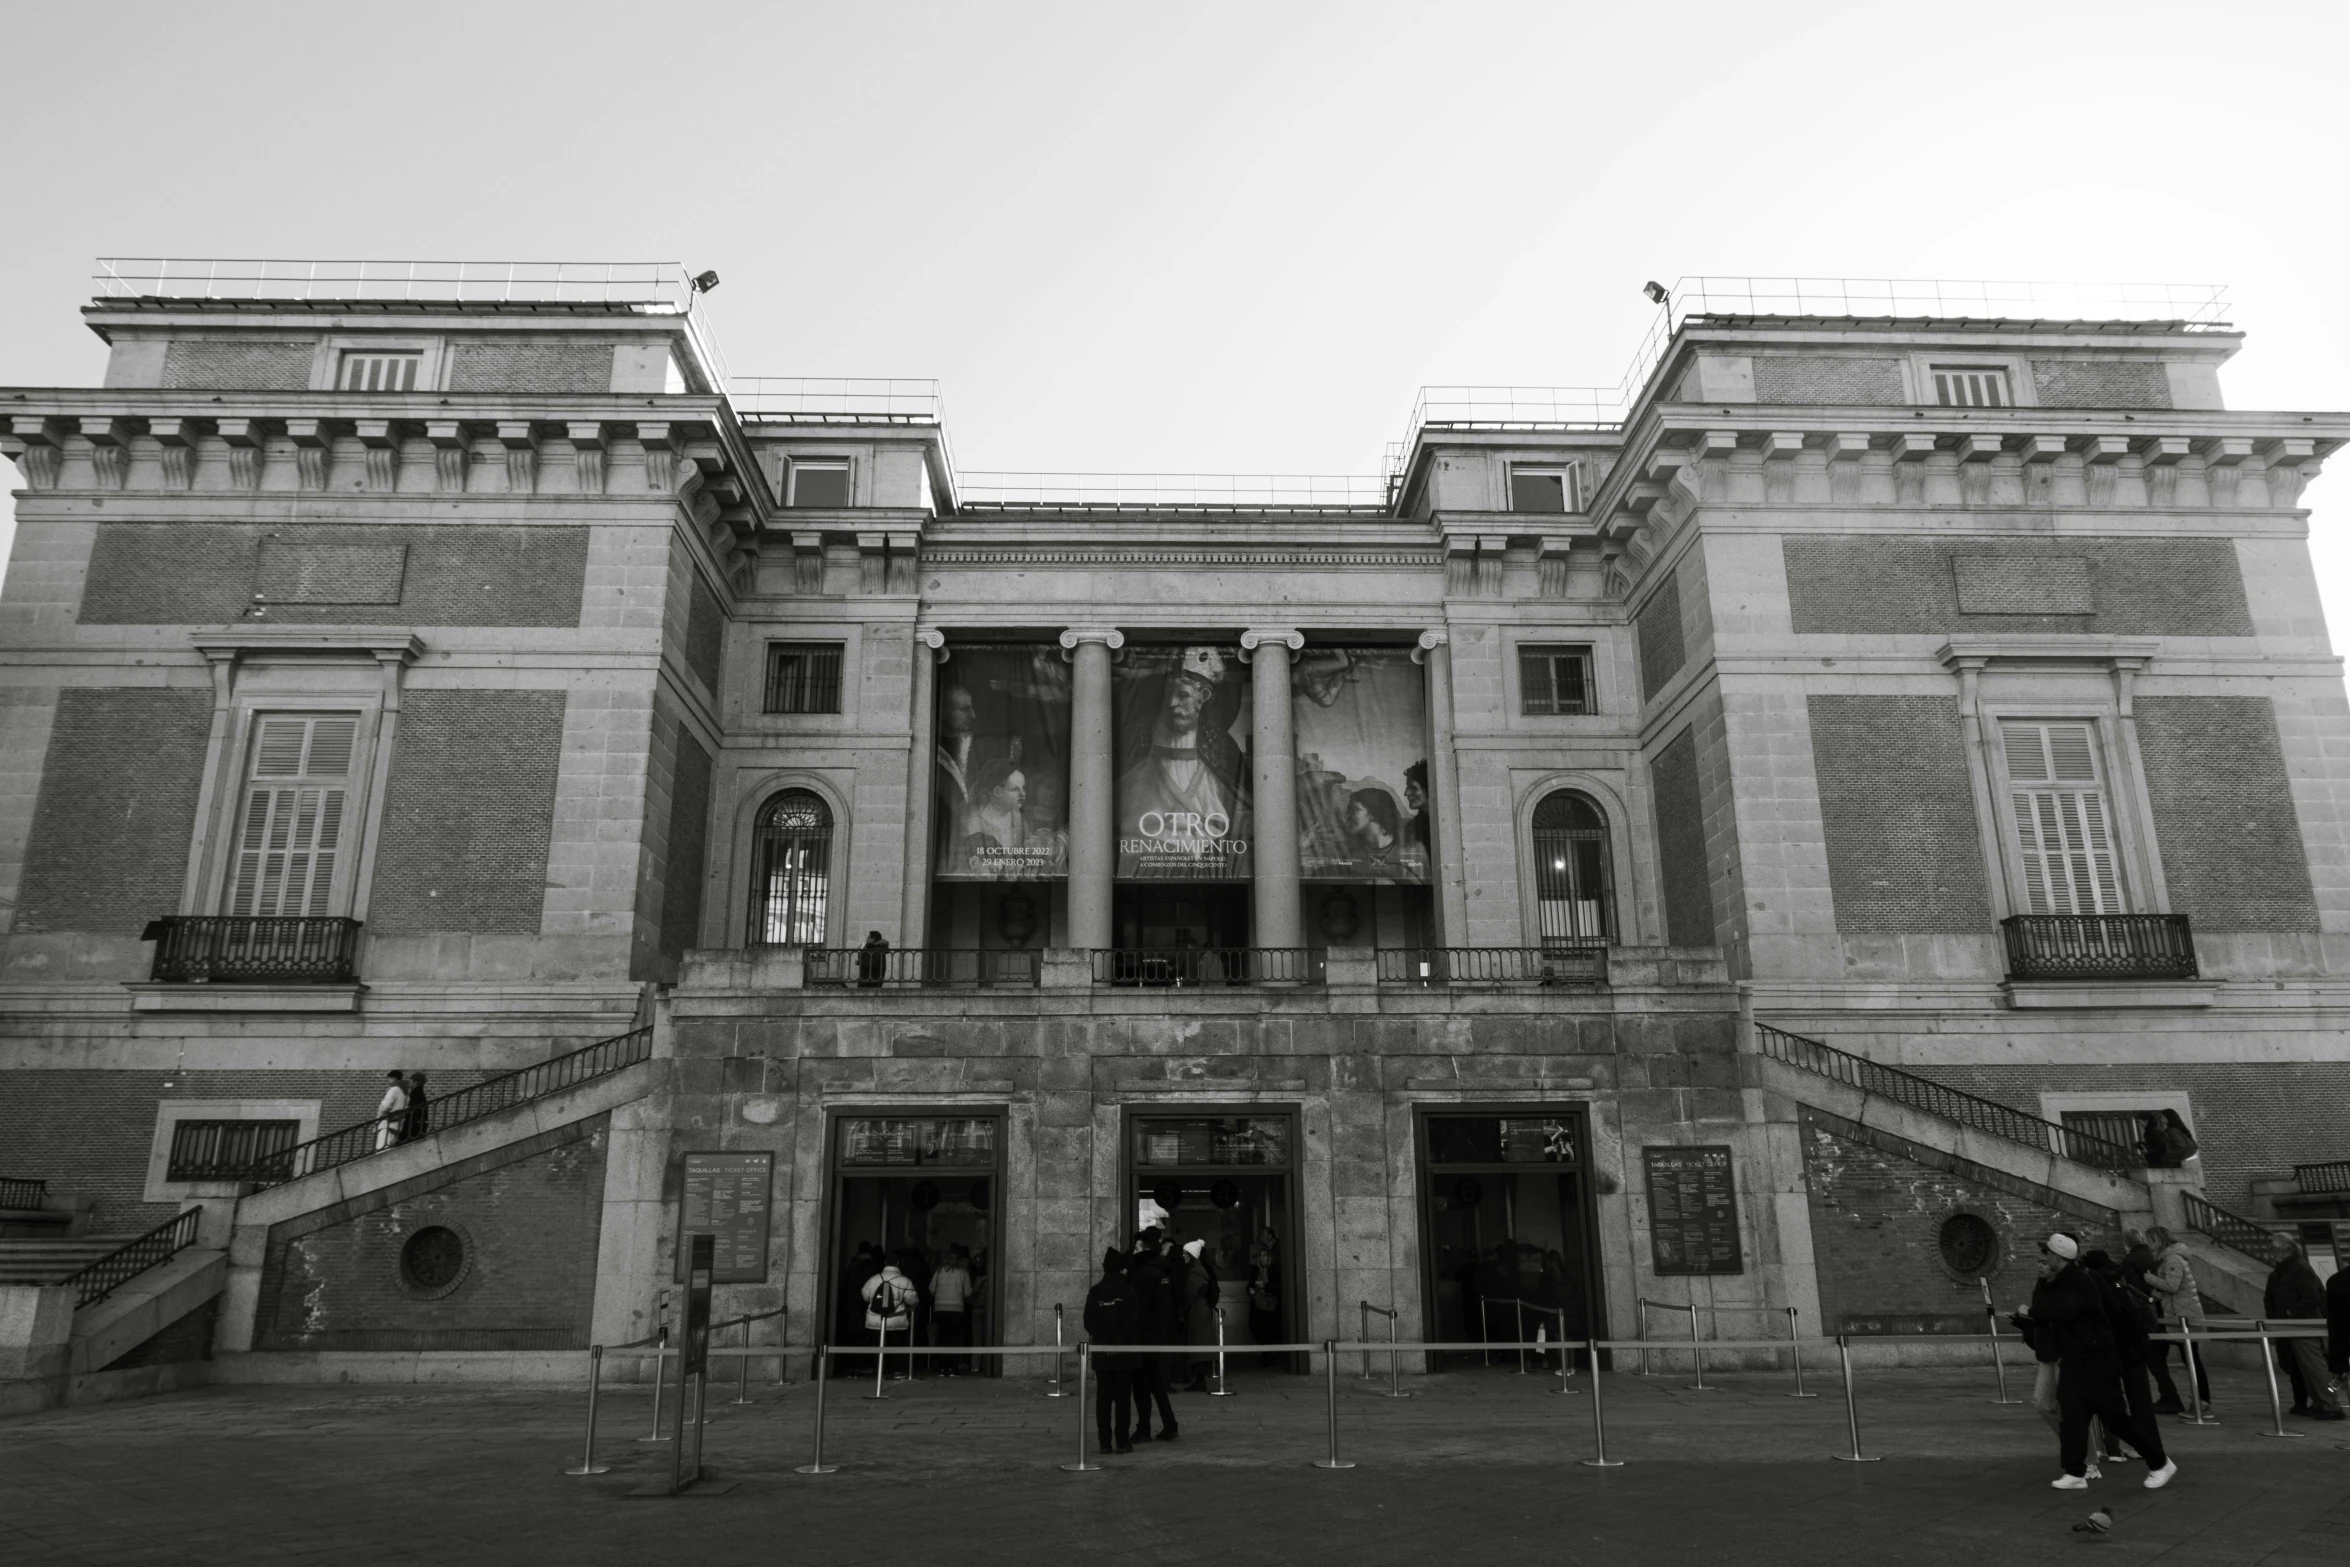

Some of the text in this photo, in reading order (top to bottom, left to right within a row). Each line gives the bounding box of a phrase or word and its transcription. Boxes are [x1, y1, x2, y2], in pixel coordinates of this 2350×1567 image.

[1138, 811, 1230, 838] OTRO
[976, 846, 1050, 855] 18 OCTUBRE 2022
[1119, 839, 1247, 854] RENACIMIENTO
[982, 858, 1044, 866] 29 ENERO 2023
[1160, 1185, 1175, 1204] 3
[1216, 1184, 1232, 1204] 4
